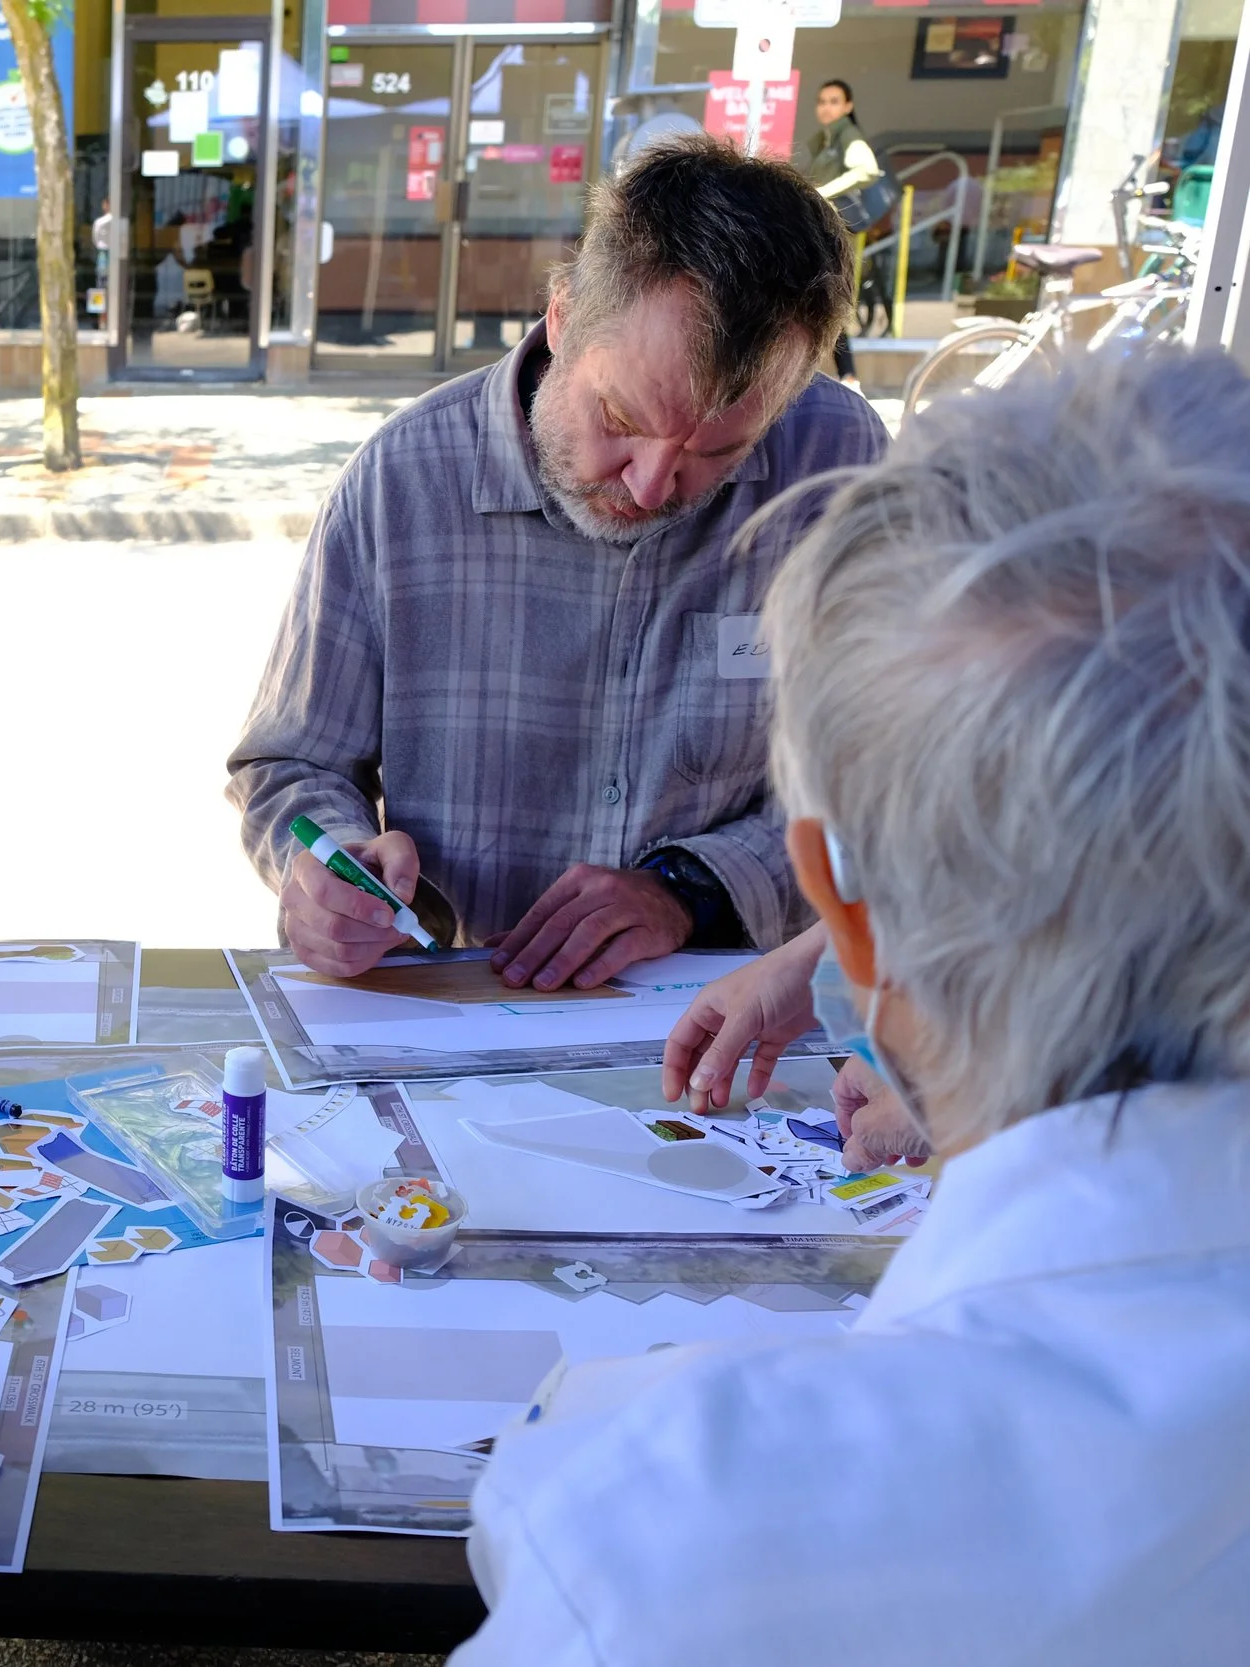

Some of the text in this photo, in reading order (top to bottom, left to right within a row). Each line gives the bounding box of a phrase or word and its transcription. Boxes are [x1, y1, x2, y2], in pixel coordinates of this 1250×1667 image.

[175, 70, 214, 91] 110
[371, 72, 411, 93] 524
[232, 1136, 239, 1147] DE
[238, 1117, 246, 1172] TRANSPARENTE
[844, 1178, 883, 1194] START
[291, 1347, 302, 1378] BELMONT
[23, 1359, 46, 1424] 6TH ST CROSSWALK
[69, 1400, 96, 1413] 28
[103, 1403, 125, 1414] m
